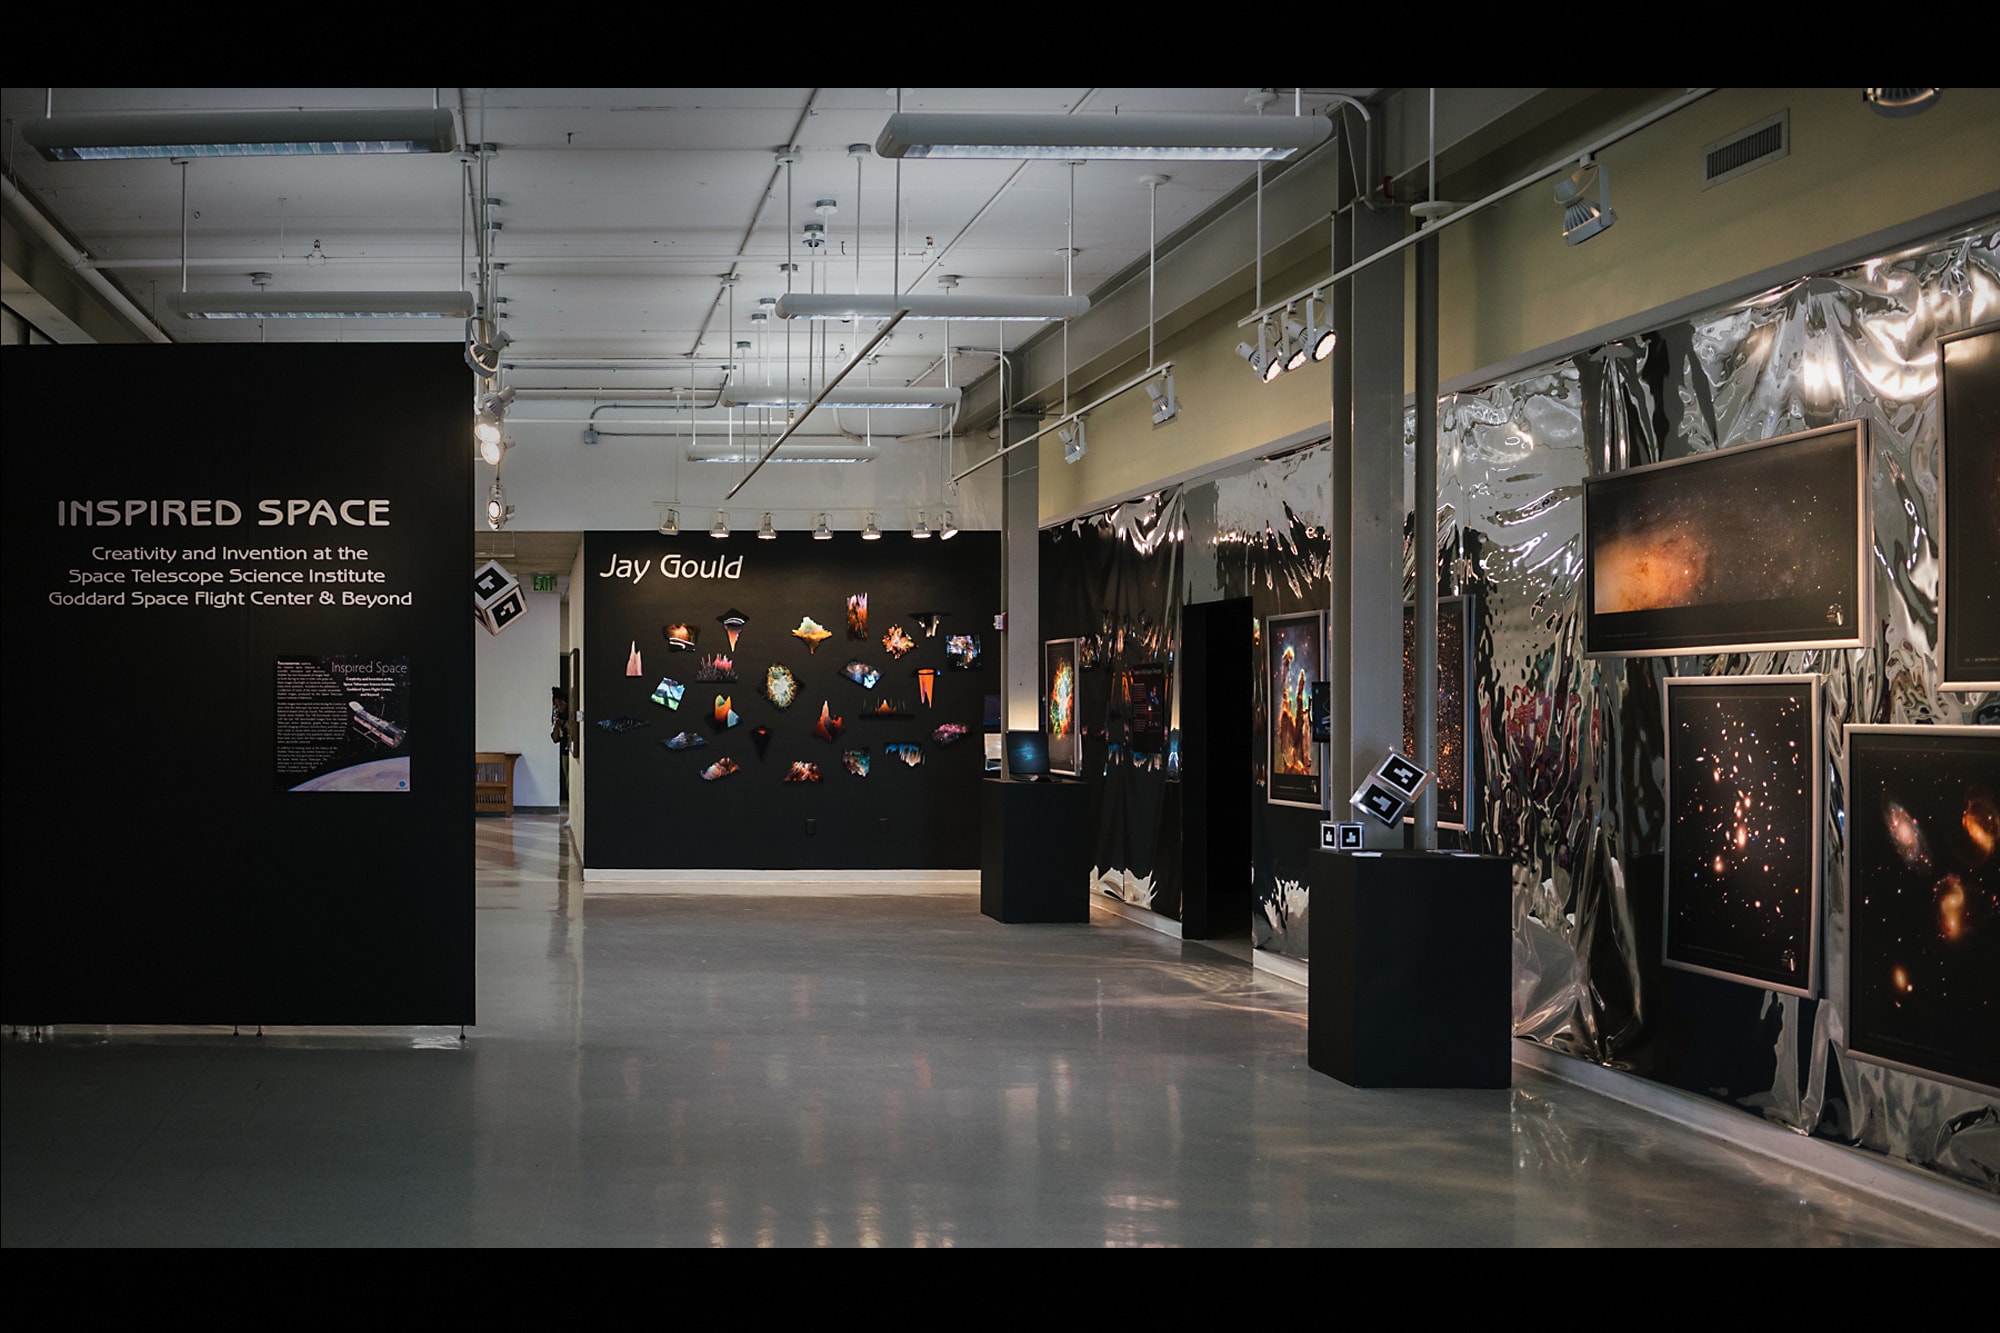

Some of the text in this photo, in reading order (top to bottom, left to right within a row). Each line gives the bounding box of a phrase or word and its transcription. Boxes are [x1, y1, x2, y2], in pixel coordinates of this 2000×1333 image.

[58, 499, 391, 527] INSPIRED SPACE
[92, 546, 369, 564] Creativity and Invention at the
[69, 568, 386, 587] Space Telescope Science Institute
[599, 553, 744, 585] Jay Gould
[533, 575, 555, 591] EXIT
[48, 590, 413, 609] Goddard Space Flight Center & Beyond
[331, 660, 373, 676] Inspired
[376, 661, 408, 676] Space
